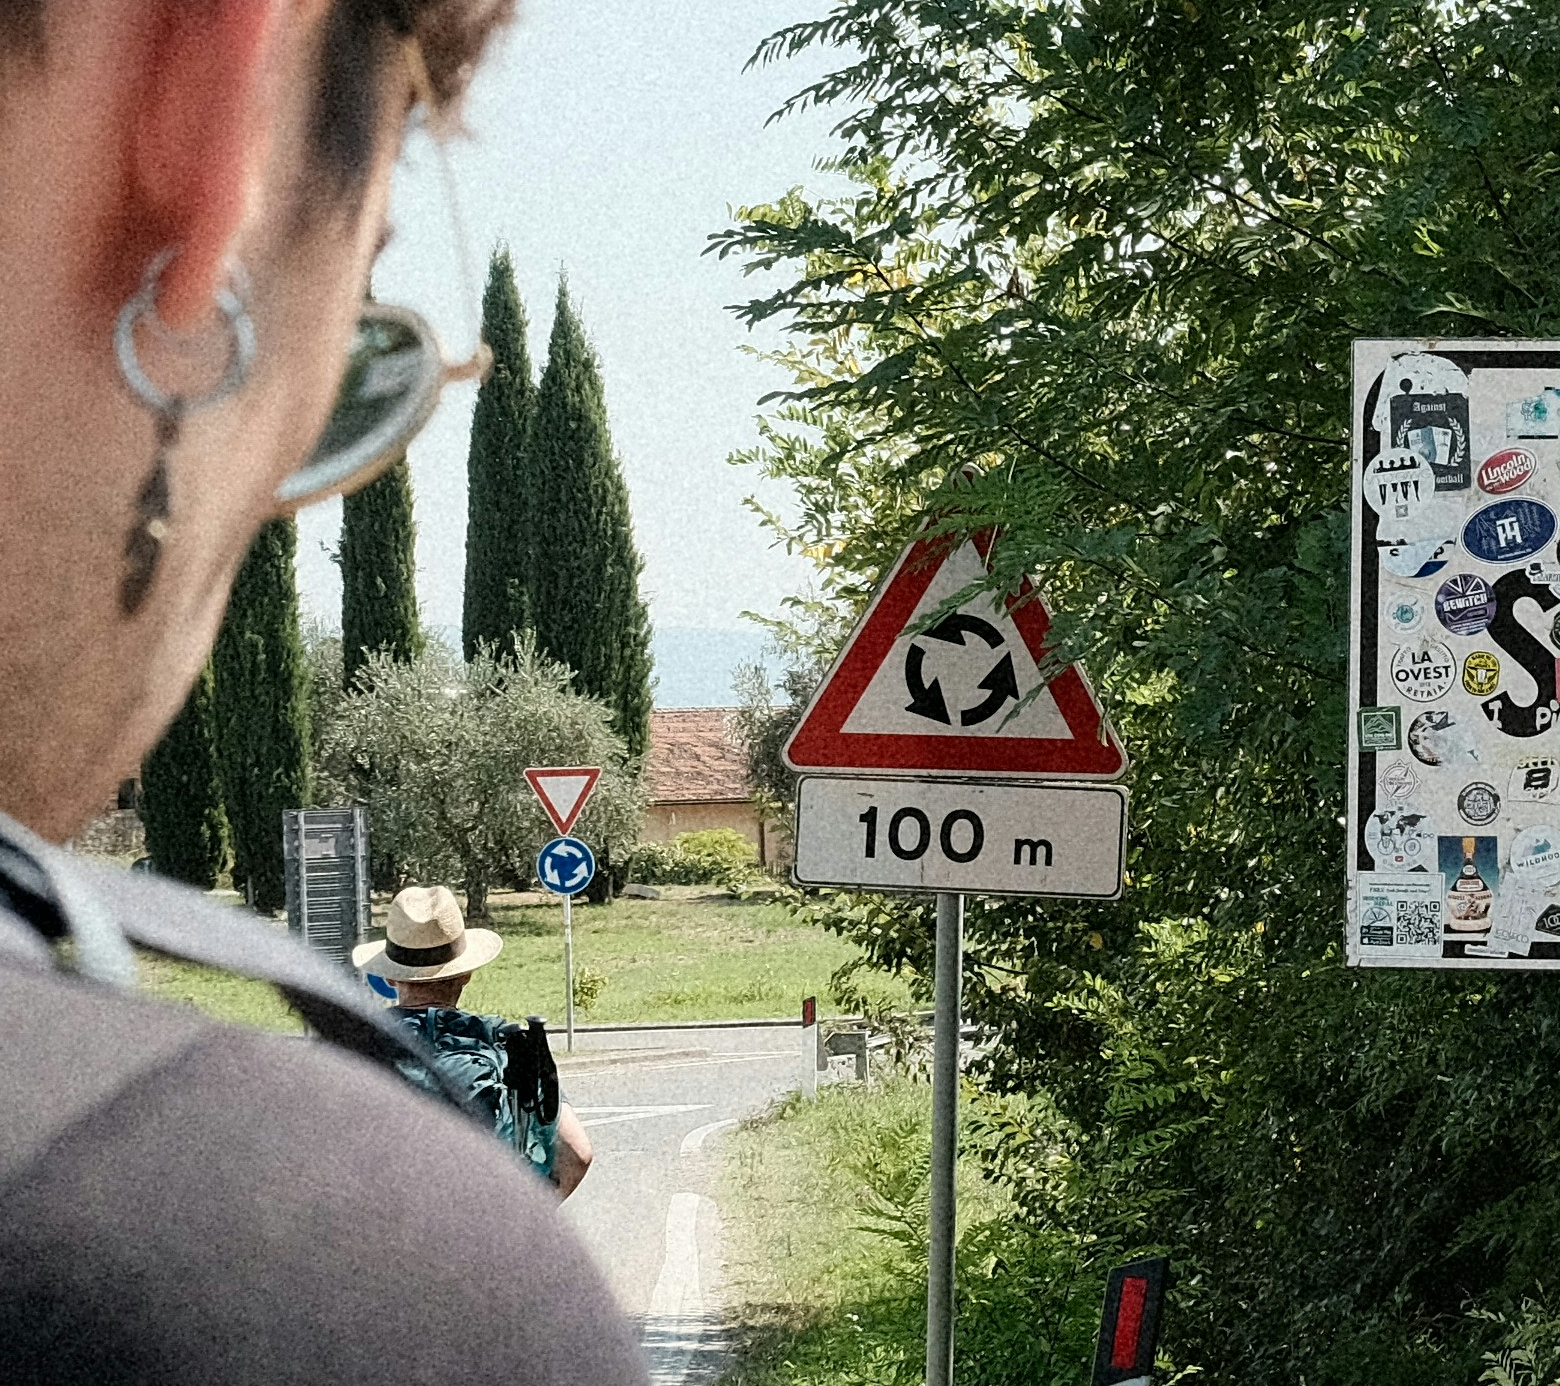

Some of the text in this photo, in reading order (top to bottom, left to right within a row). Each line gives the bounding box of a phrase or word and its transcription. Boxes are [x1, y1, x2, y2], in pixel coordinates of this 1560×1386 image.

[1411, 651, 1431, 664] LA
[1395, 665, 1451, 682] OVEST
[858, 806, 1054, 867] 100 m
